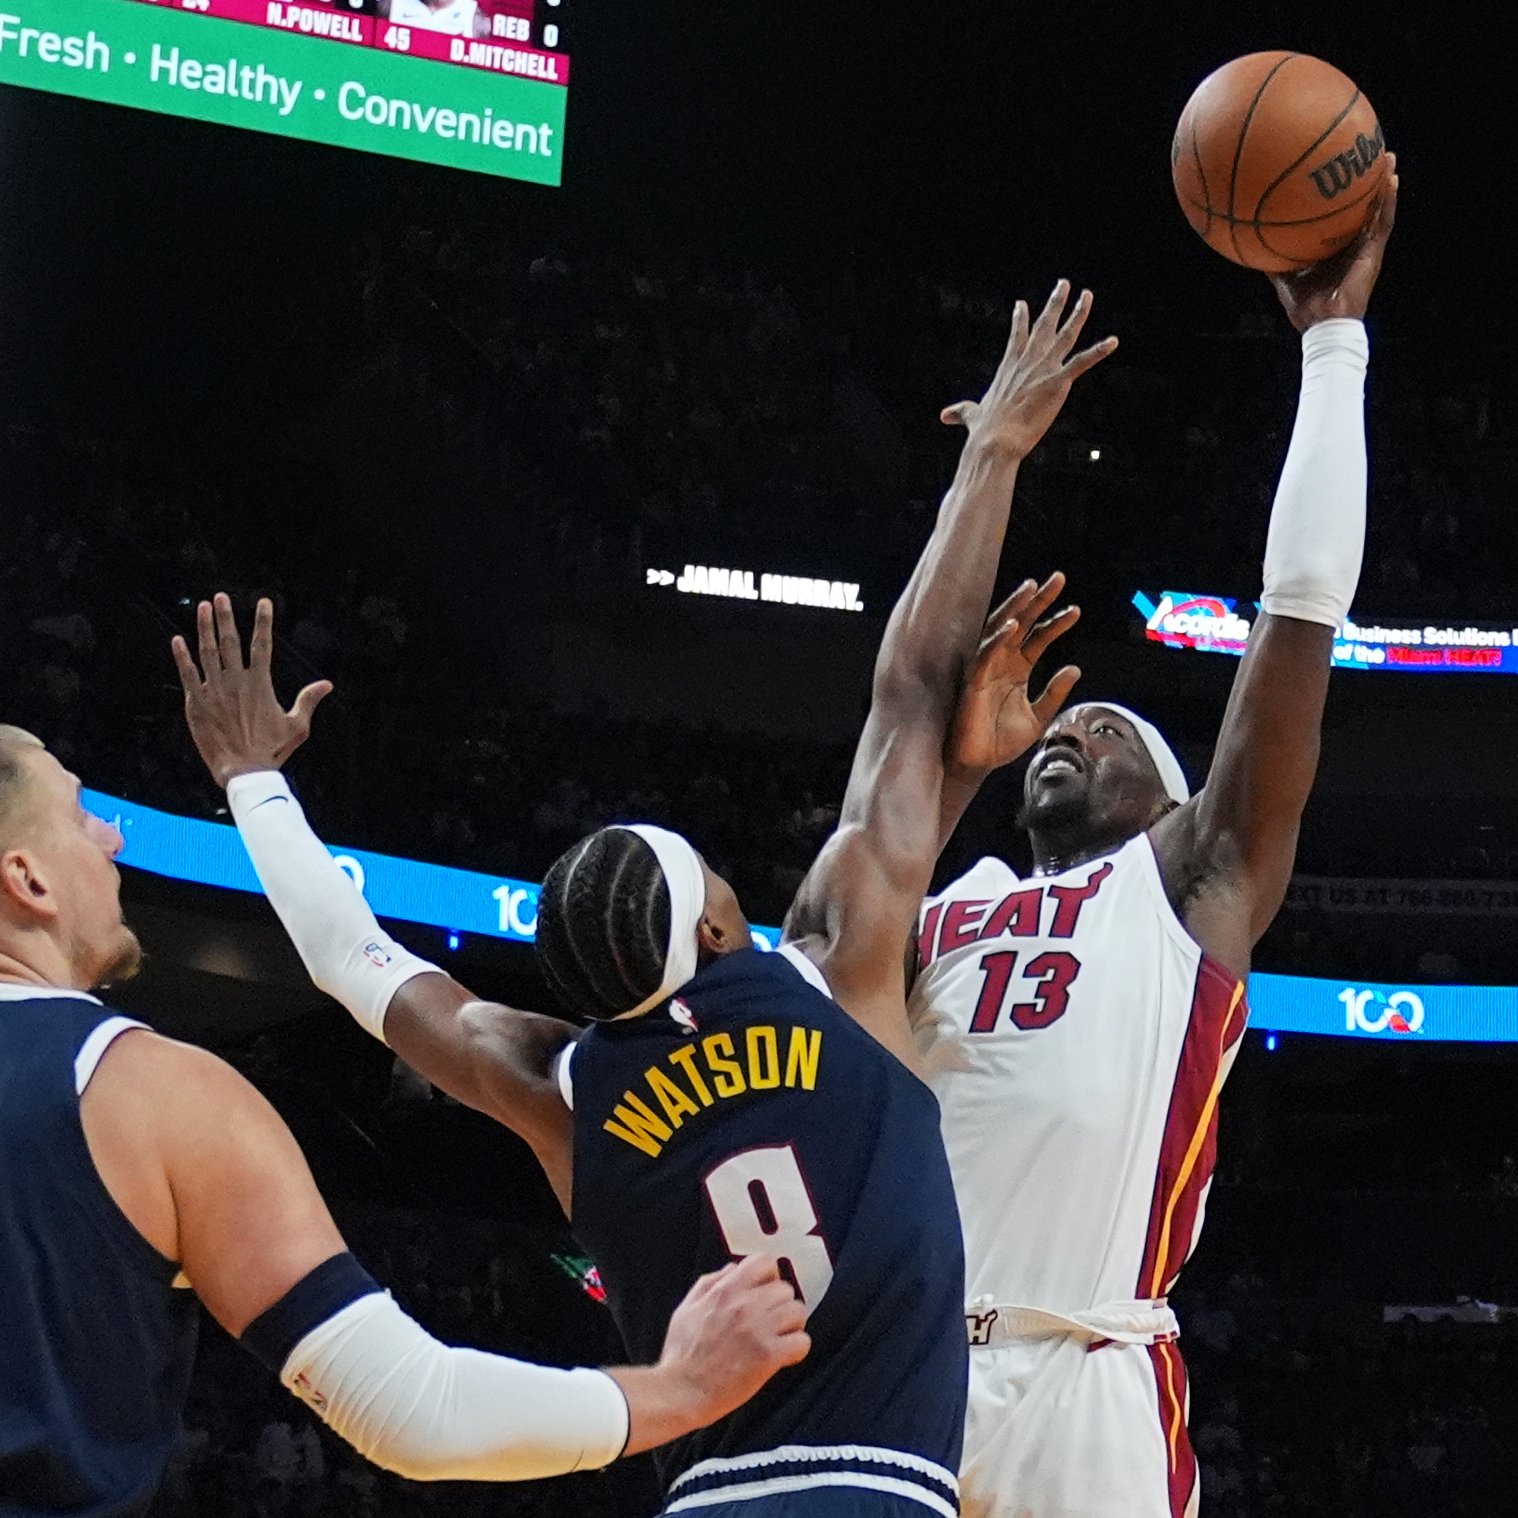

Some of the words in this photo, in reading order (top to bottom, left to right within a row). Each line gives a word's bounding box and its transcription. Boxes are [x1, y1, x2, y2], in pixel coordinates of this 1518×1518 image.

[266, 2, 363, 41] N.POWELL
[492, 13, 530, 41] REB
[543, 23, 559, 48] 0
[384, 26, 411, 51] 45
[449, 38, 558, 80] D.MITCHELL
[149, 44, 302, 116] Healthy
[338, 81, 554, 156] Convenient
[677, 564, 758, 600] JAMAL
[1333, 644, 1353, 660] of
[1354, 644, 1386, 664] the
[1342, 622, 1422, 644] Business
[1423, 627, 1510, 647] Solutions
[492, 885, 539, 935] 10
[968, 951, 1083, 1034] 13
[1338, 987, 1425, 1034] 100
[603, 1024, 822, 1159] WATSON
[702, 1141, 836, 1319] 8
